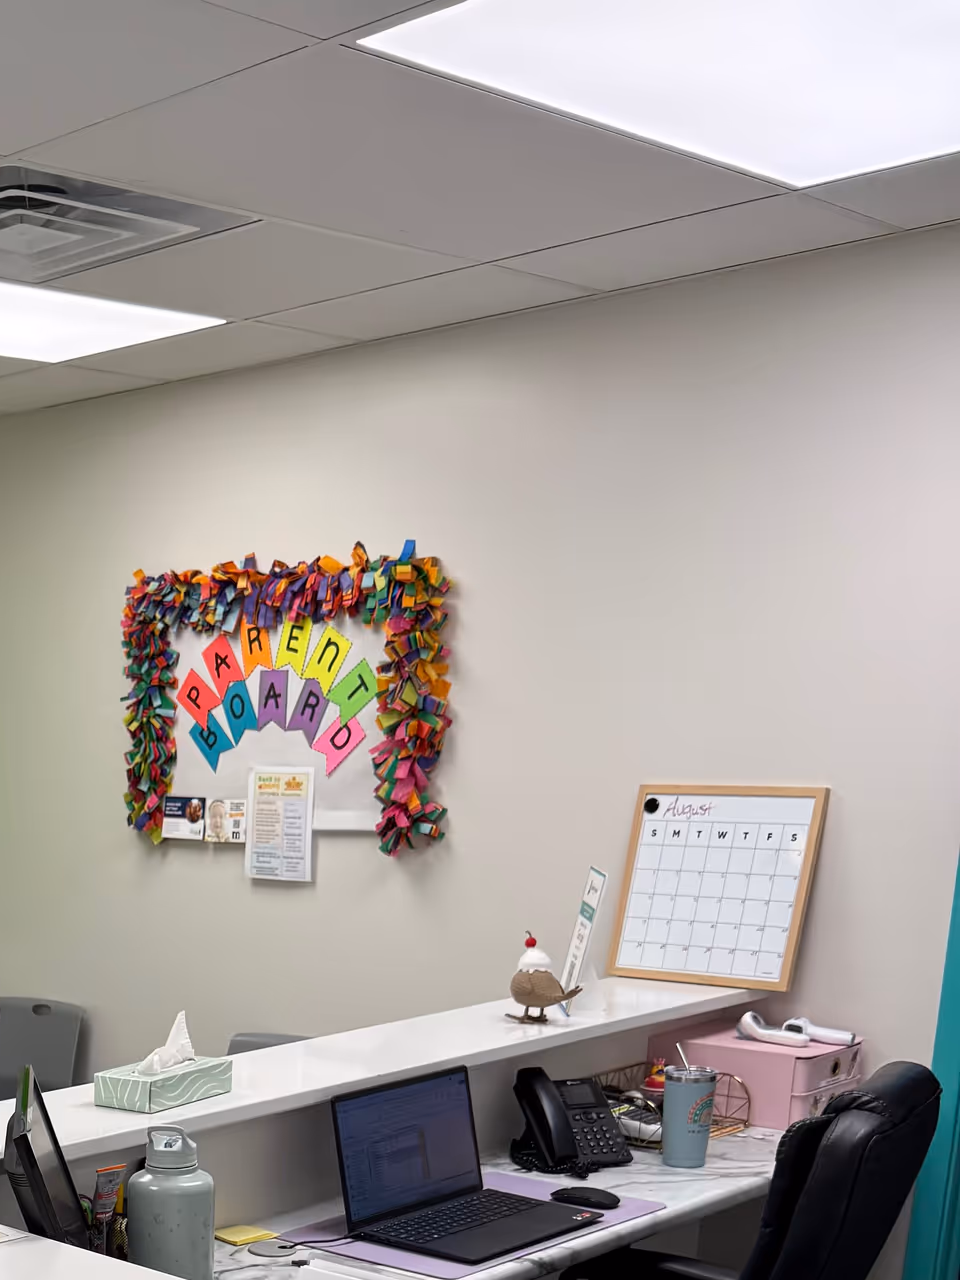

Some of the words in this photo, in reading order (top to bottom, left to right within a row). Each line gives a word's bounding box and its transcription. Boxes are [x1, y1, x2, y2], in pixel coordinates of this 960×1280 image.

[199, 682, 352, 751] BOARD
[663, 795, 714, 820] August
[651, 829, 657, 837] S
[672, 830, 681, 838] M
[696, 831, 703, 839] T
[717, 831, 728, 839] W
[743, 832, 749, 840] T
[766, 833, 773, 841] F
[790, 834, 798, 842] S
